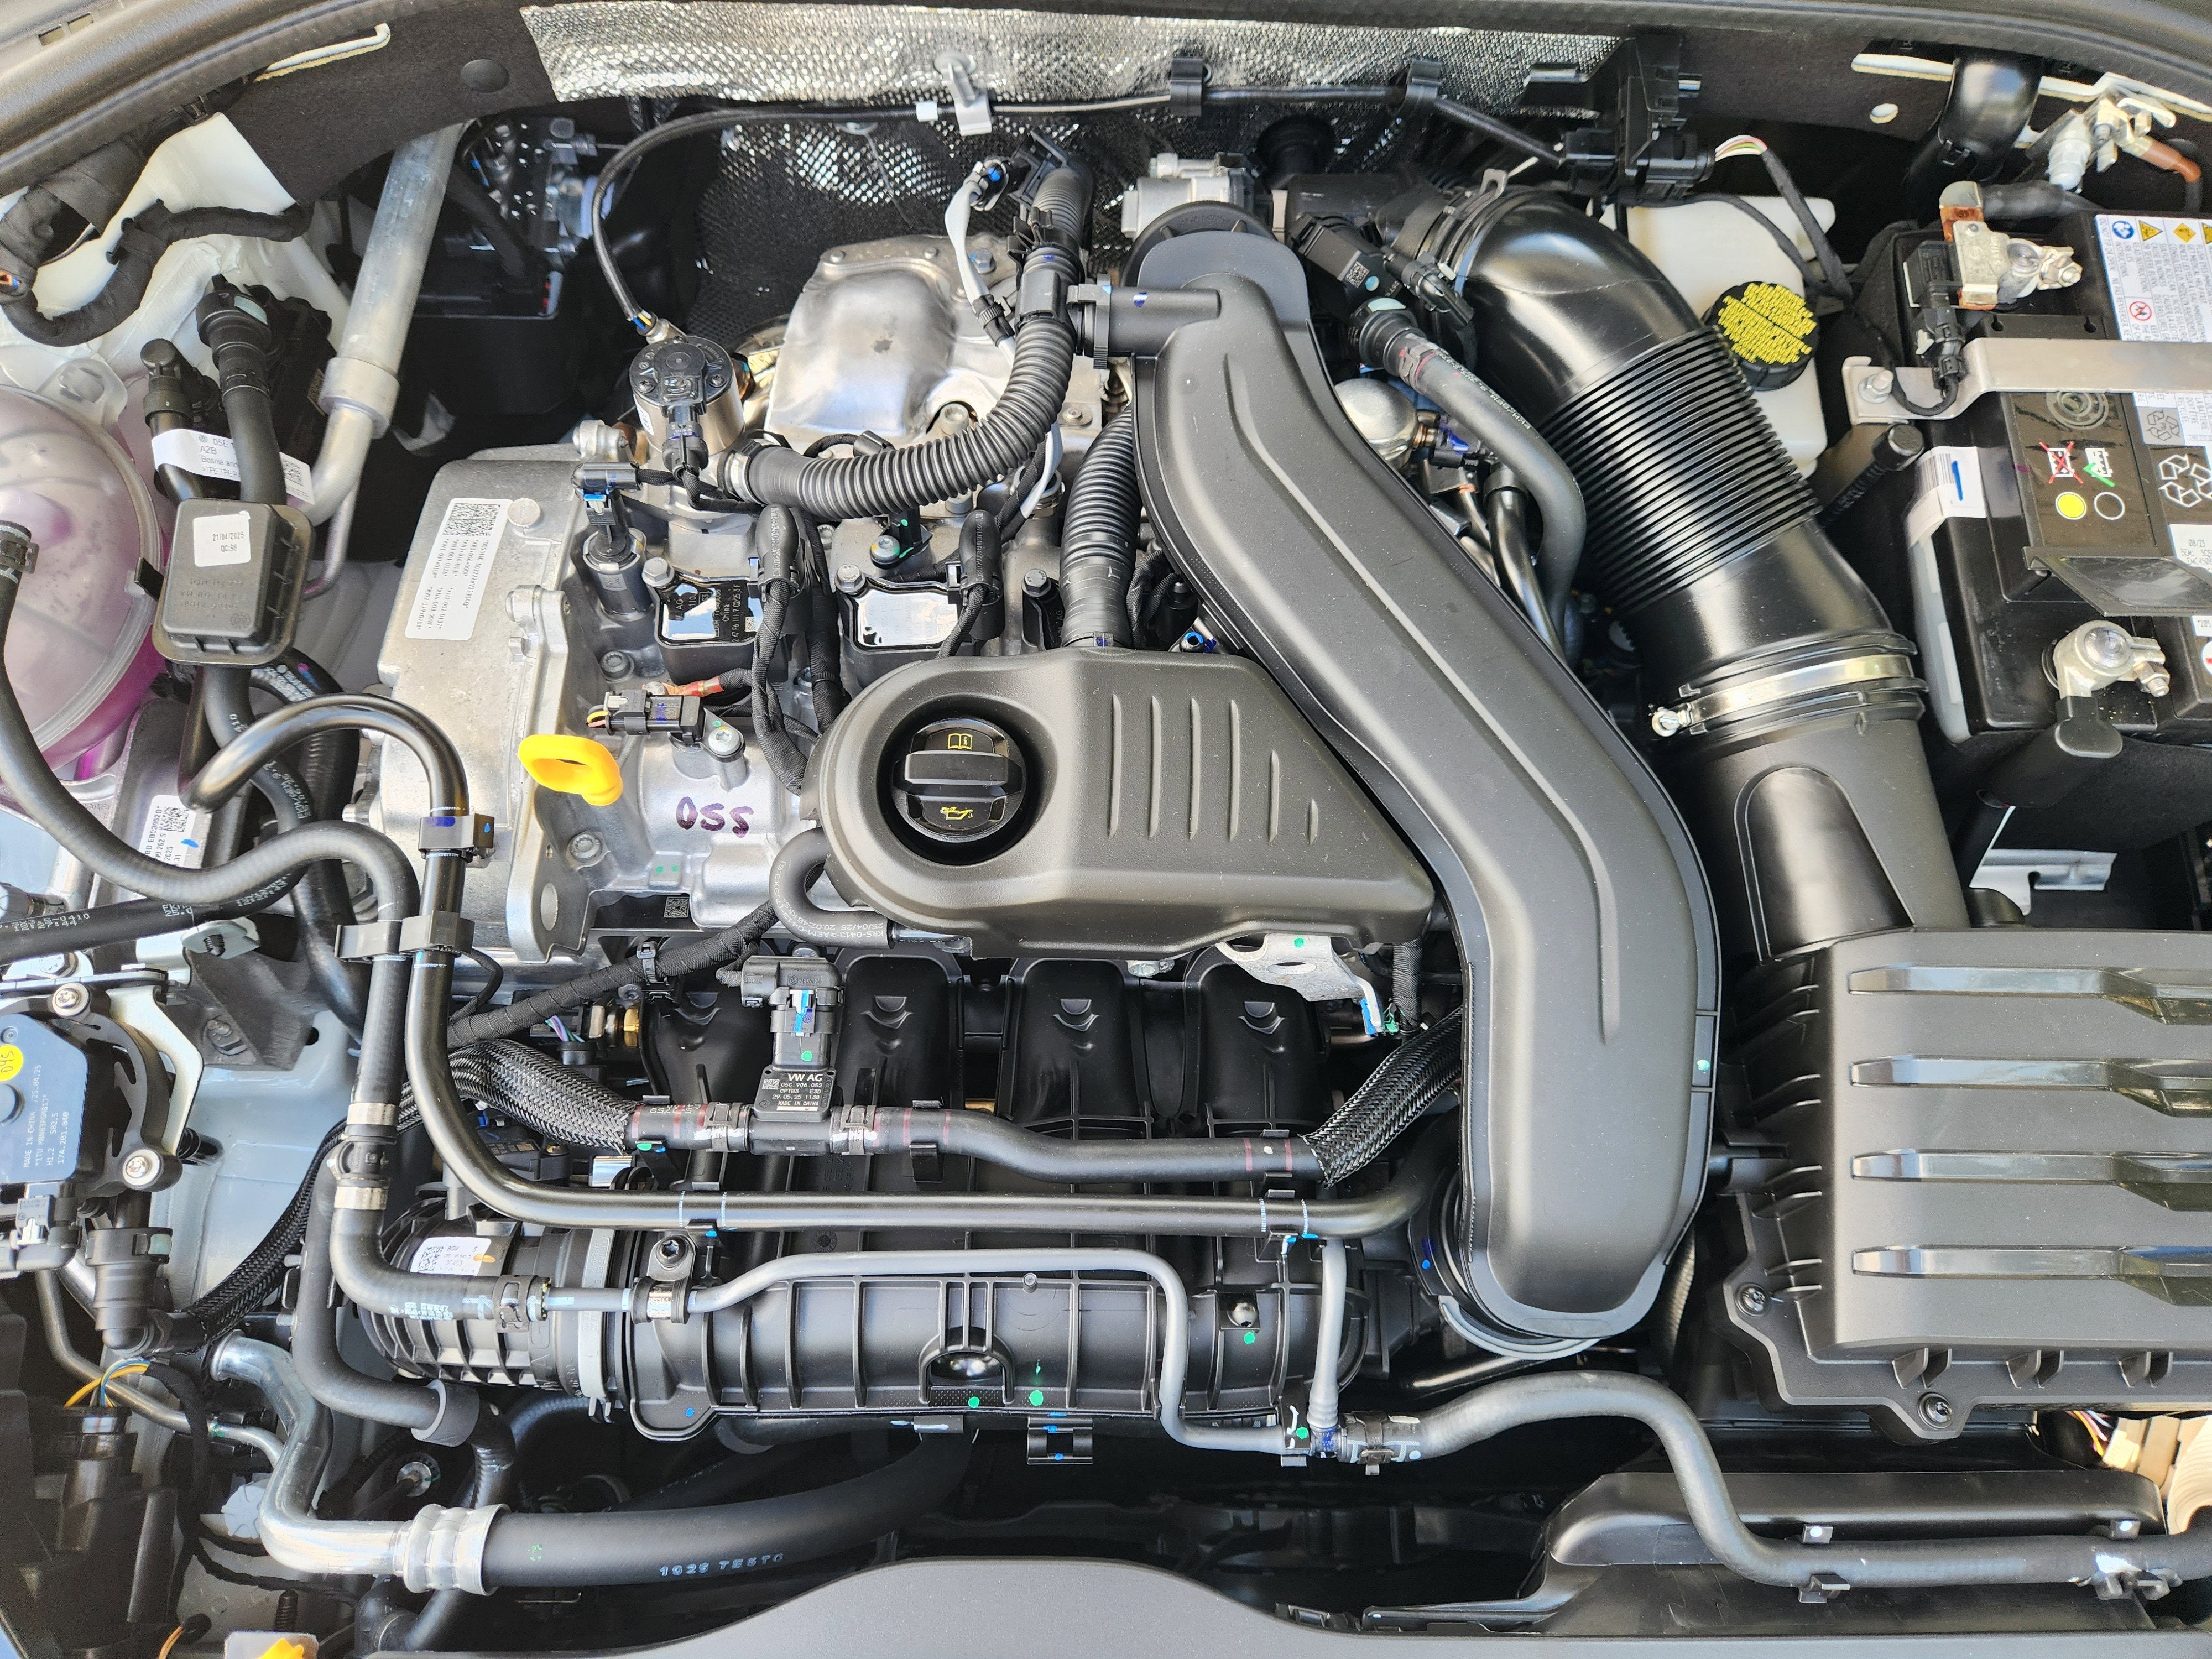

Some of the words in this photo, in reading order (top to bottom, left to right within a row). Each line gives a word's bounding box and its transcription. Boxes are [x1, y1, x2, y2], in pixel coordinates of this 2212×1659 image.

[200, 446, 217, 455] AZB
[201, 455, 224, 465] Bosnia
[212, 531, 244, 541] 21/04/2025
[788, 1073, 805, 1082] VW
[28, 1110, 36, 1133] CHINA
[25, 1136, 33, 1146] IN
[58, 1111, 69, 1164] 17A.201.040
[23, 1149, 32, 1167] MADE
